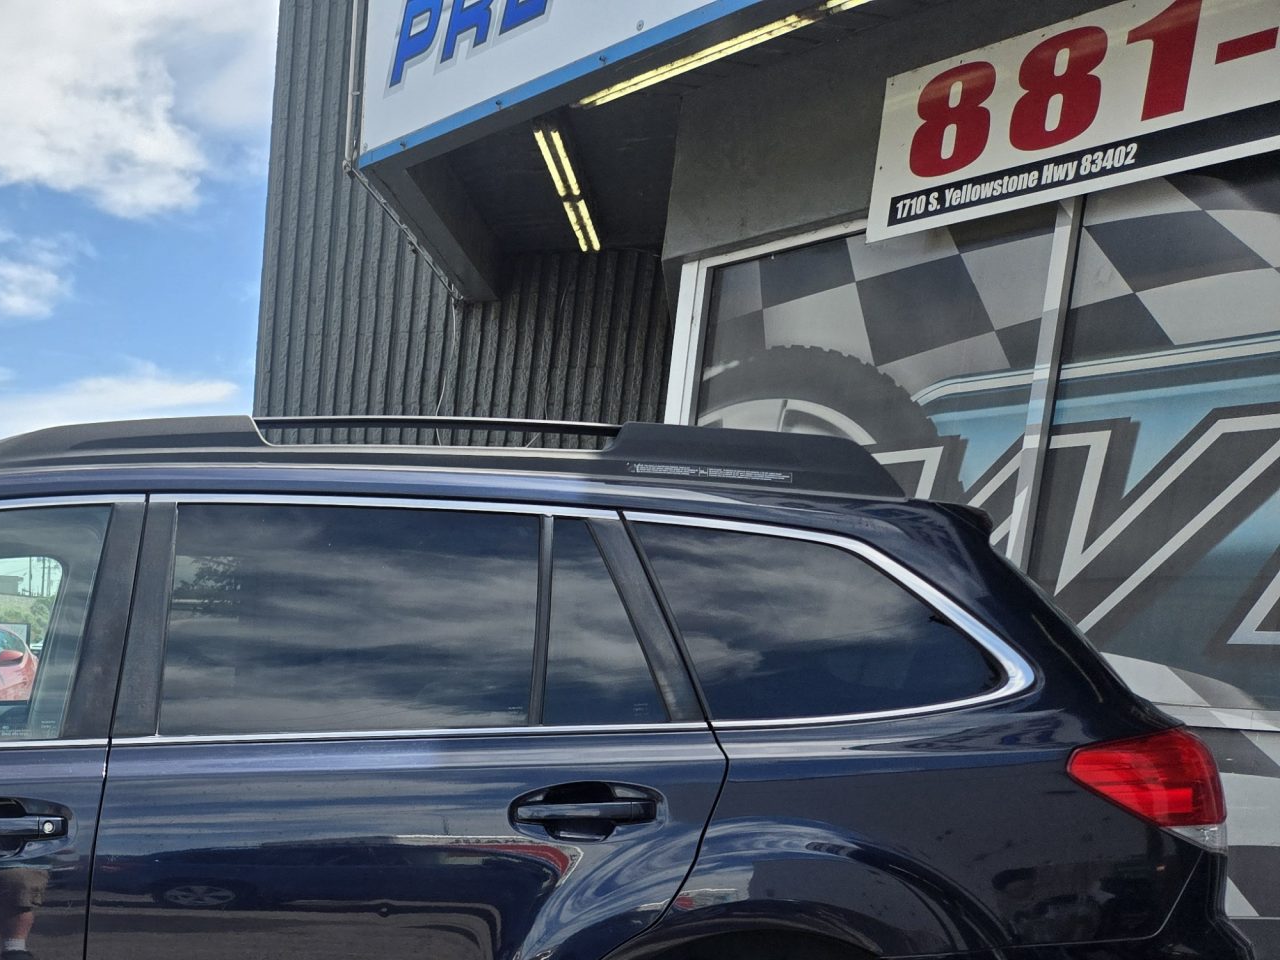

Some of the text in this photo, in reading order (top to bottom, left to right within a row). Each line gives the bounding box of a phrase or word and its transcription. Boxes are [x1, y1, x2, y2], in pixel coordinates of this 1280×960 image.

[909, 0, 1279, 178] 881-
[896, 143, 1138, 219] 1710 S. Yellowstone Hwy 83402
